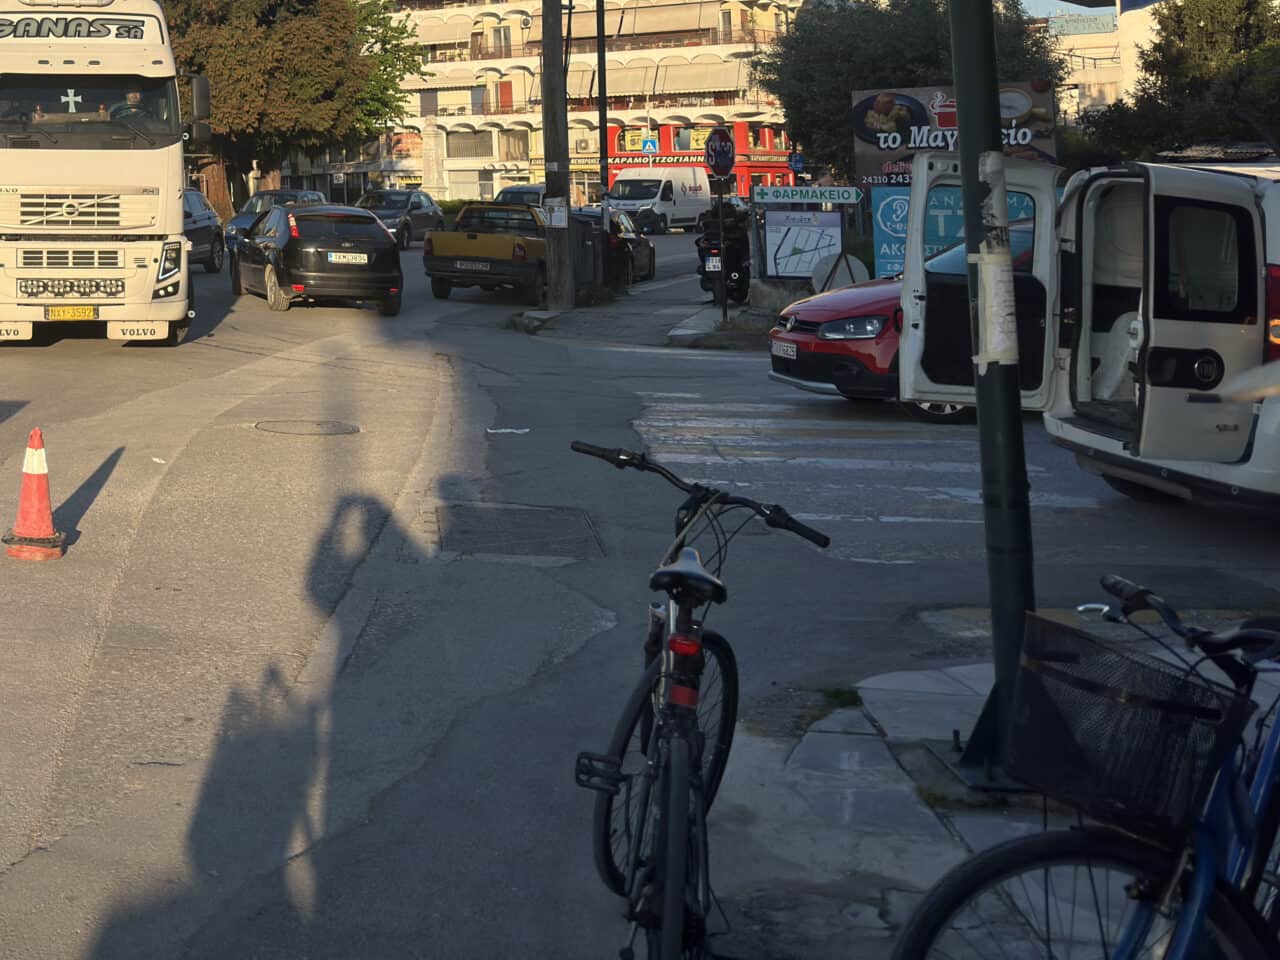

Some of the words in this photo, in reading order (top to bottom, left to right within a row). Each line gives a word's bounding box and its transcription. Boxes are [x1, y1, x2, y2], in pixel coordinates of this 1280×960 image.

[116, 25, 144, 39] SA
[876, 132, 902, 149] το
[607, 155, 705, 164] ΚΑΡΑΜΟΥΤΖΟΓΙΑΝΝ
[772, 189, 851, 200] ΦΑΡΜΑΚΕΙΟ
[120, 328, 157, 337] VOLVO
